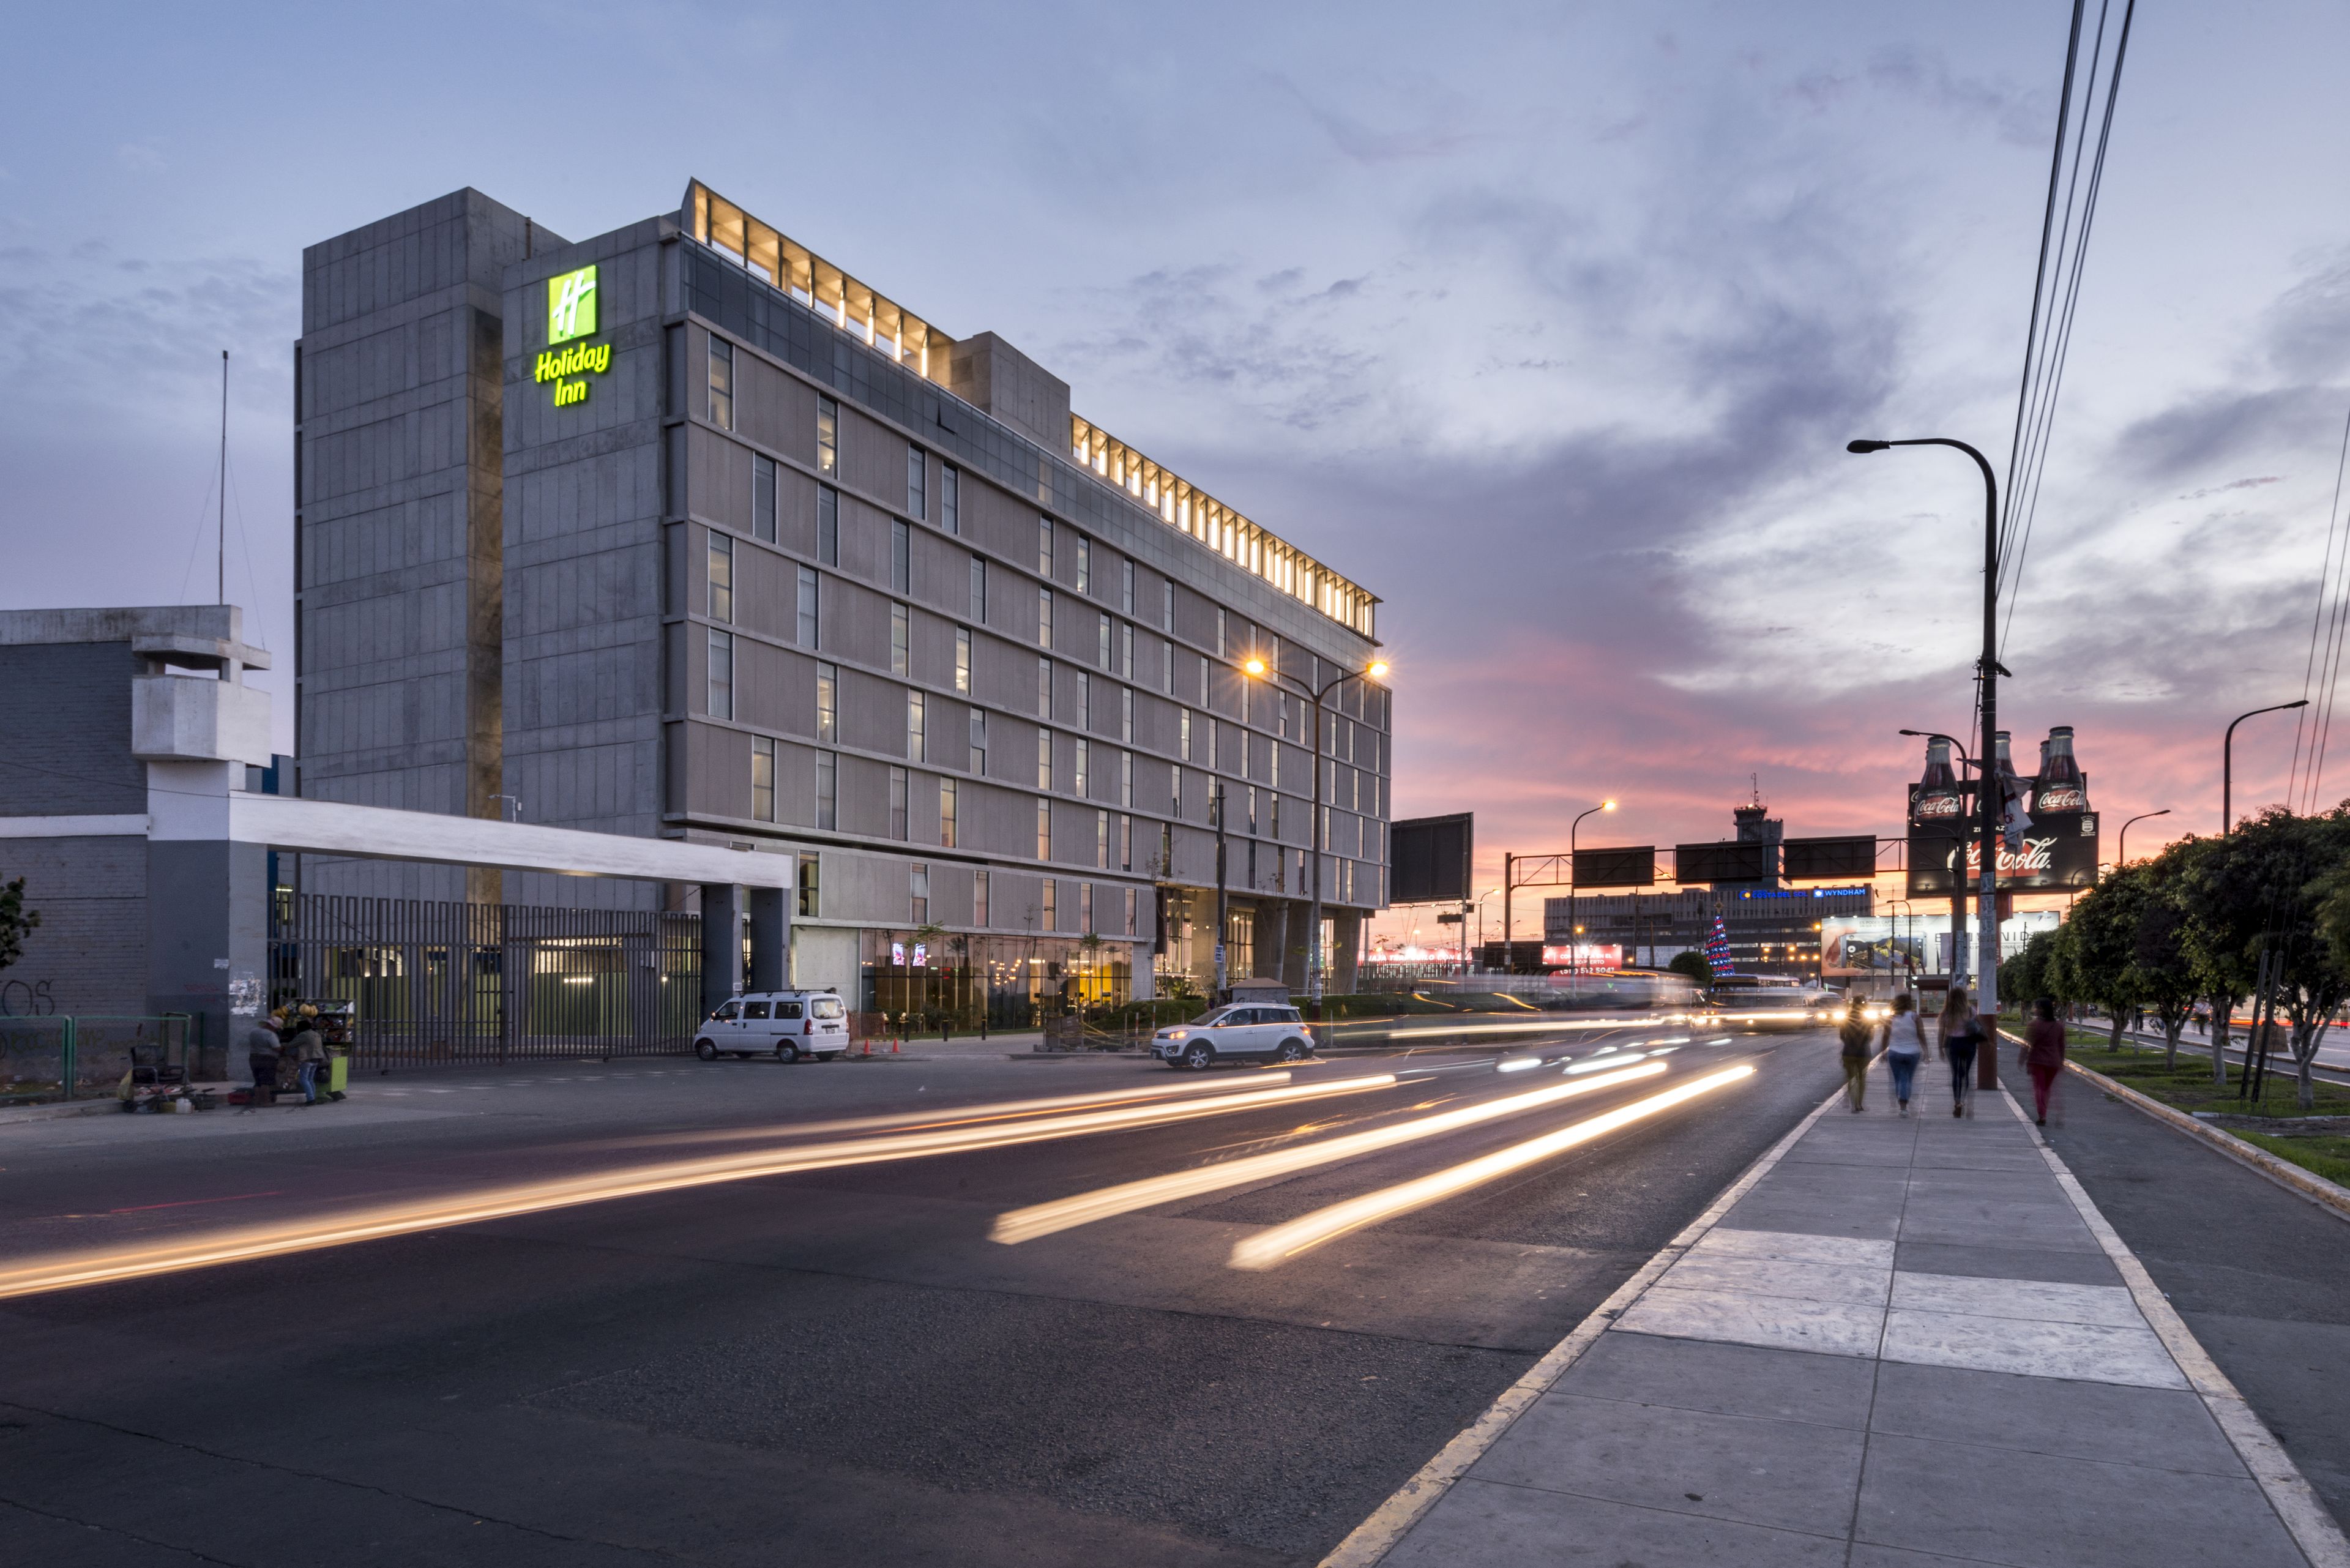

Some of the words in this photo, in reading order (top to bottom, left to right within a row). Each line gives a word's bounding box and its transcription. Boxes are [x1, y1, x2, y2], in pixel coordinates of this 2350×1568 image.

[535, 342, 610, 383] Holiday
[554, 378, 586, 407] Inn
[1917, 797, 1959, 816] Coca-Cola
[2039, 790, 2084, 809] Coca-Cola
